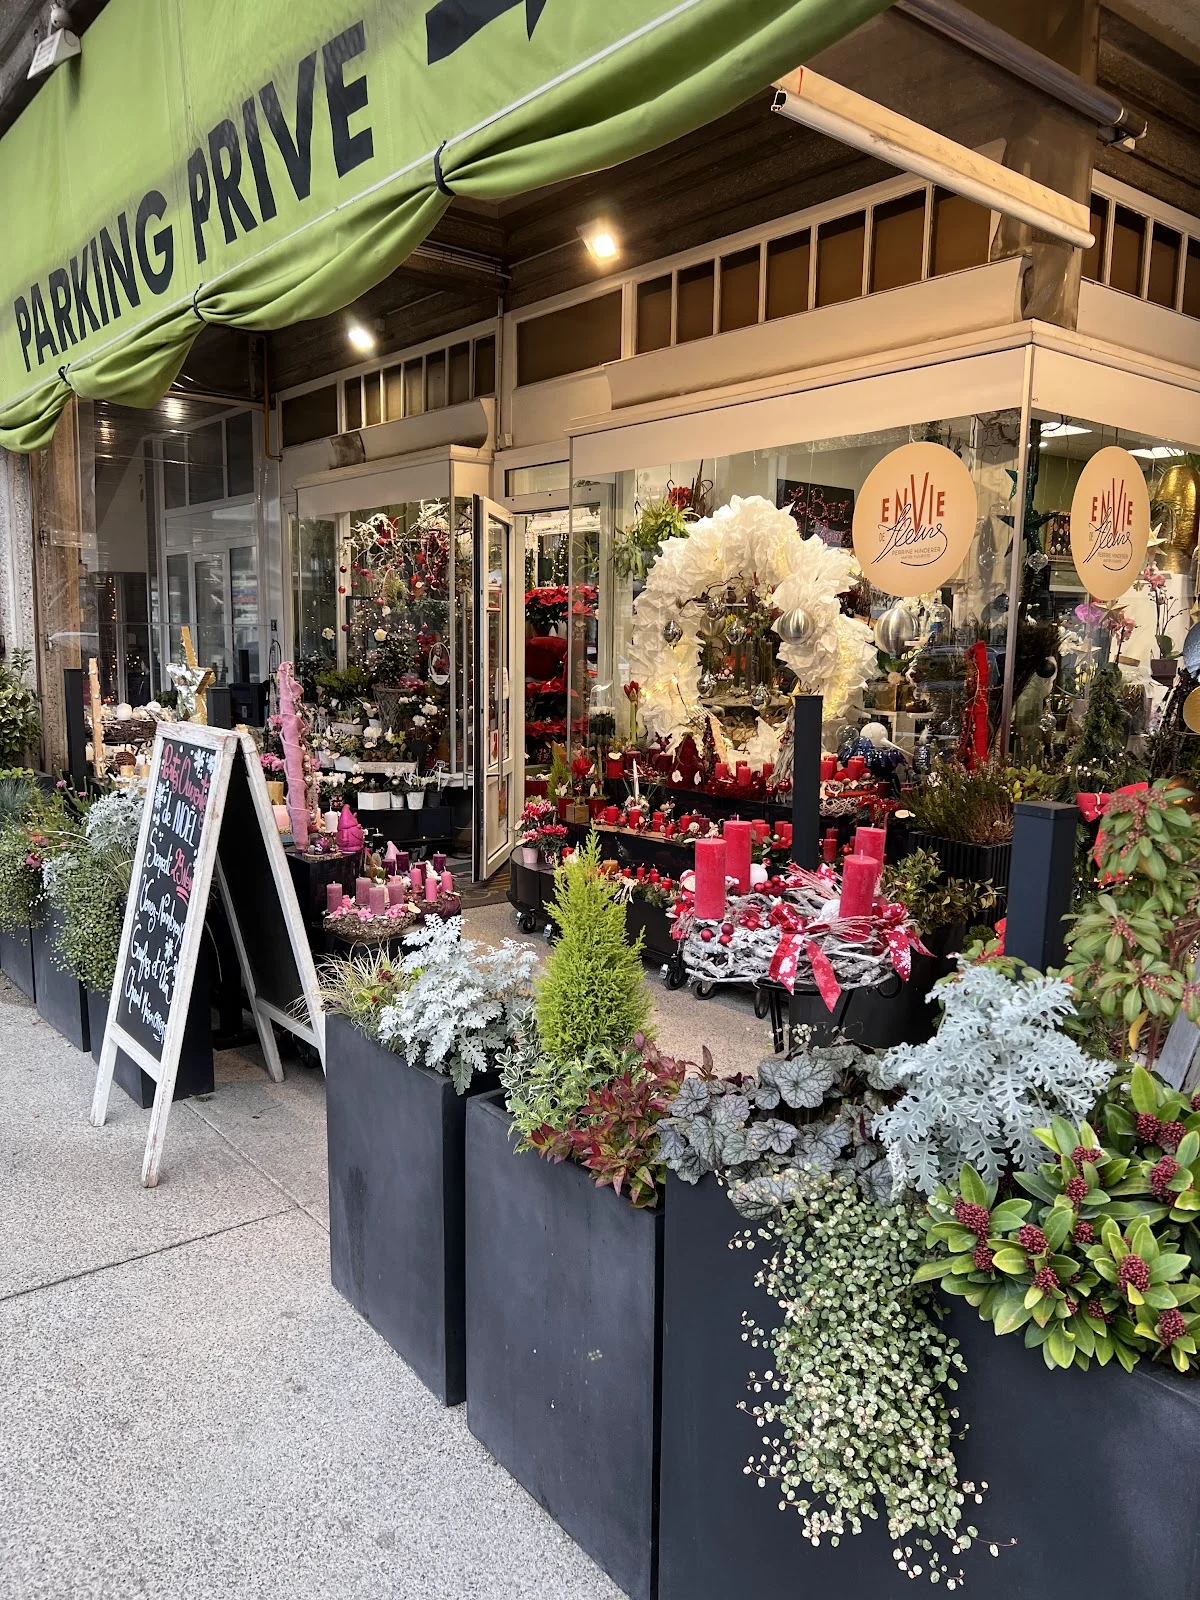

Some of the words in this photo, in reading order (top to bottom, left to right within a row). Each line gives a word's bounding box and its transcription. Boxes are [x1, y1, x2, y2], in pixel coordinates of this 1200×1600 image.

[13, 190, 174, 373] PARKING
[187, 20, 374, 264] PRIVE
[882, 472, 945, 533] ENVIE
[1091, 478, 1133, 538] ENVIE
[879, 532, 885, 542] DE
[162, 791, 172, 828] de
[172, 800, 198, 847] NOËL
[146, 828, 173, 879] Samedi
[152, 948, 162, 980] et
